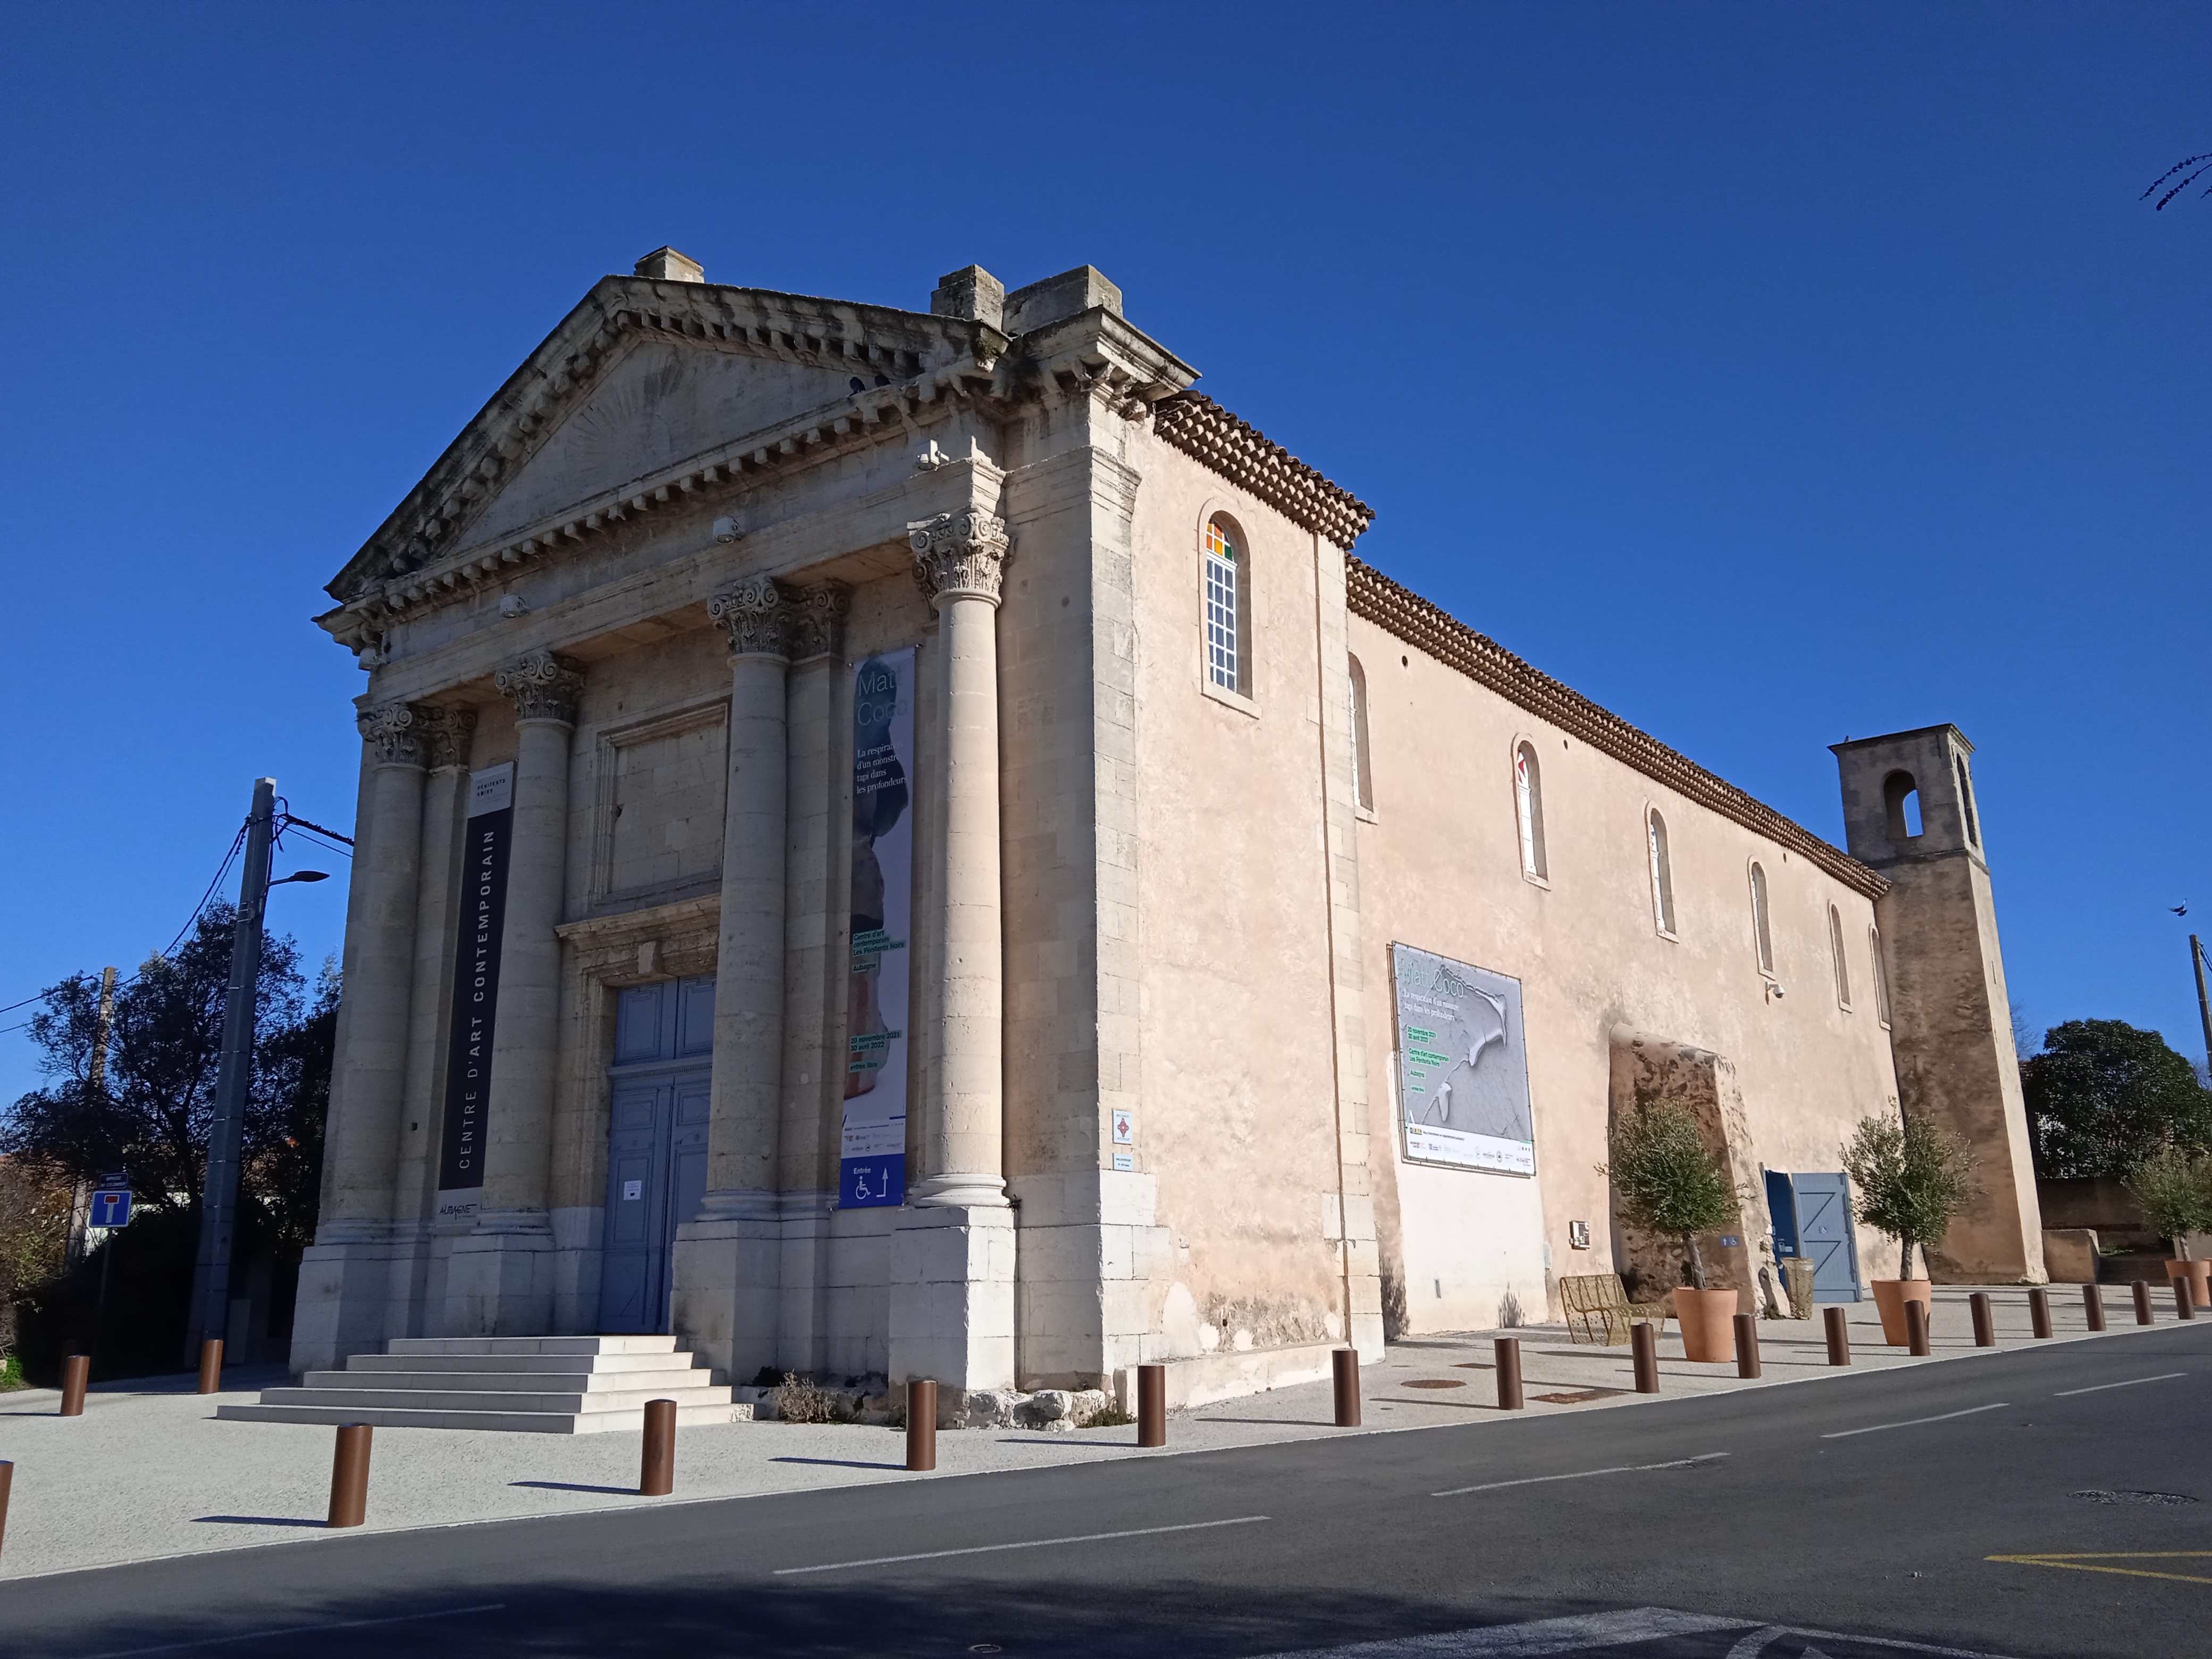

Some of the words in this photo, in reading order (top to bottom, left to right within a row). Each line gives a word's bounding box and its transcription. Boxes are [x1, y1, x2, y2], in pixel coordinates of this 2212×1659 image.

[858, 700, 908, 726] Coco
[857, 749, 866, 758] La
[857, 760, 871, 770] d'un
[857, 771, 869, 783] tapi
[870, 769, 887, 778] dans
[857, 785, 866, 794] les
[867, 777, 907, 793] profondeurs
[473, 831, 495, 1003] CONTEMPORAIN
[853, 936, 889, 948] contemporain
[853, 963, 876, 971] Aubagne
[1402, 959, 1430, 988] Matt
[1434, 969, 1463, 999] Coco
[1404, 988, 1410, 998] La
[858, 1034, 885, 1043] novembre
[467, 1017, 482, 1078] D'ART
[459, 1091, 477, 1170] CENTRE
